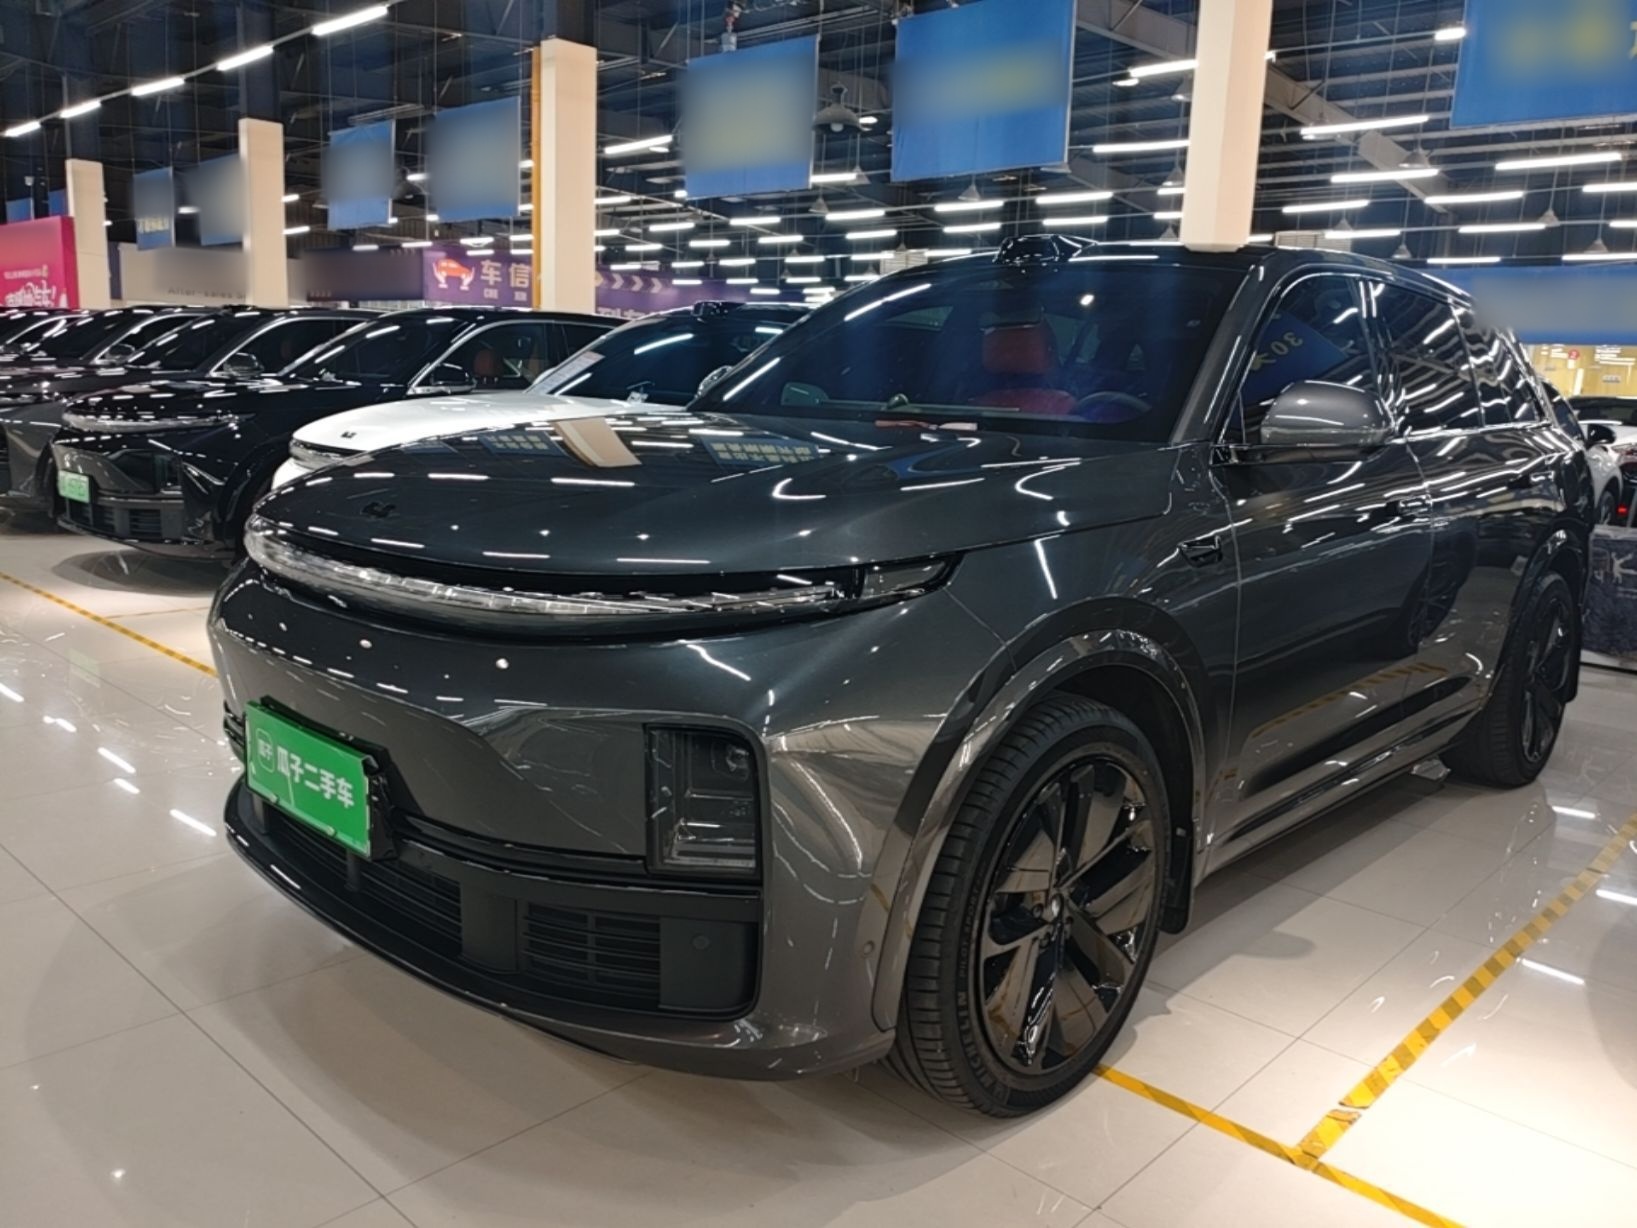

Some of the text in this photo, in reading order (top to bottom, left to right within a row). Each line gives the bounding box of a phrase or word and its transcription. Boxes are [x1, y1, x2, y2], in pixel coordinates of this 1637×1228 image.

[277, 746, 354, 808] 瓜子二手车
[957, 992, 993, 1088] MICHELIN
